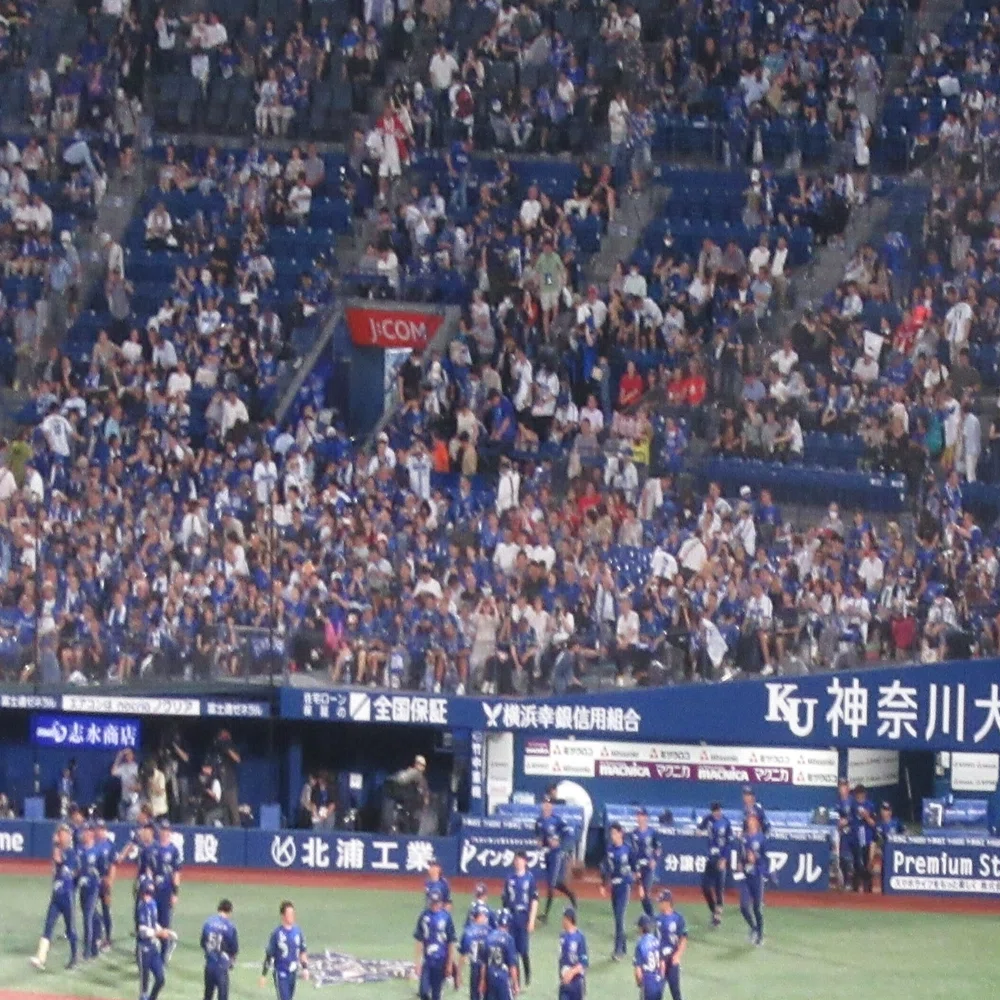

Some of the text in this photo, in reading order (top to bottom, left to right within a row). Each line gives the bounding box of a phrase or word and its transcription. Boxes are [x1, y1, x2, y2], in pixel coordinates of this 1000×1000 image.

[369, 316, 428, 344] J:COM
[373, 694, 448, 724] 全国保証
[502, 703, 641, 732] 横浜幸銀信用組合
[656, 764, 691, 779] マクニカ
[754, 768, 789, 783] マクニカ
[302, 837, 435, 871] 北浦工業
[893, 850, 973, 876] Premium
